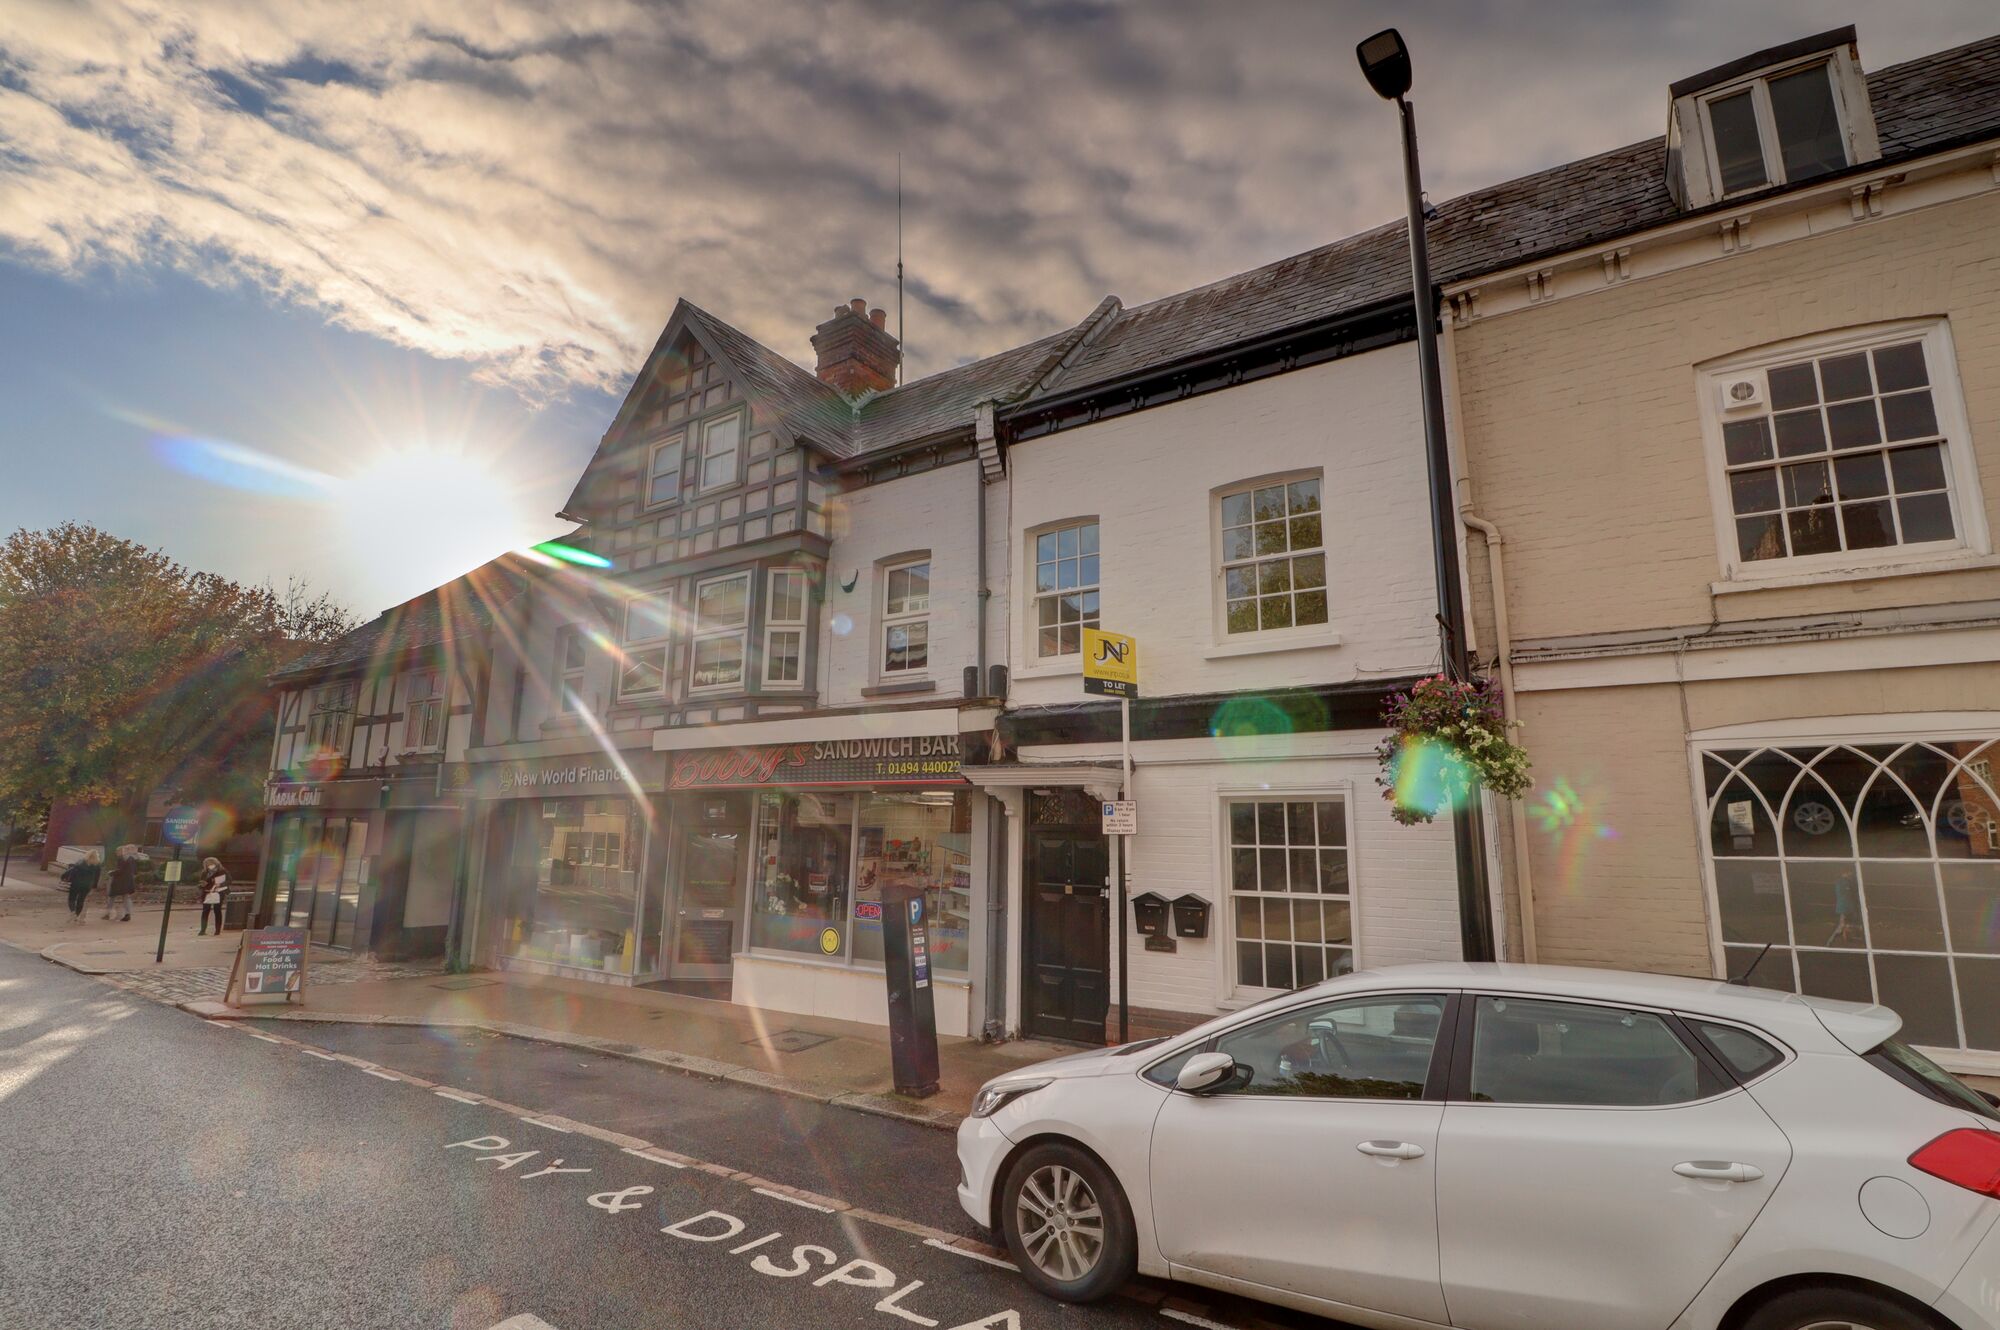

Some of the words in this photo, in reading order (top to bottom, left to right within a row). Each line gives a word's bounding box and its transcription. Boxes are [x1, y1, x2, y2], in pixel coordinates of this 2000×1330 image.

[1114, 682, 1126, 690] LET
[814, 738, 913, 760] SANDWICH
[919, 735, 960, 756] BAR
[670, 743, 810, 788] Bobby's
[876, 763, 886, 774] T.
[888, 762, 919, 774] 01494
[514, 772, 538, 786] New
[542, 767, 576, 785] World
[579, 766, 629, 783] Finance
[165, 817, 199, 825] SANDWICH
[857, 906, 881, 917] OPEN
[910, 901, 919, 920] P
[444, 1135, 593, 1180] PAY
[587, 1185, 655, 1214] &
